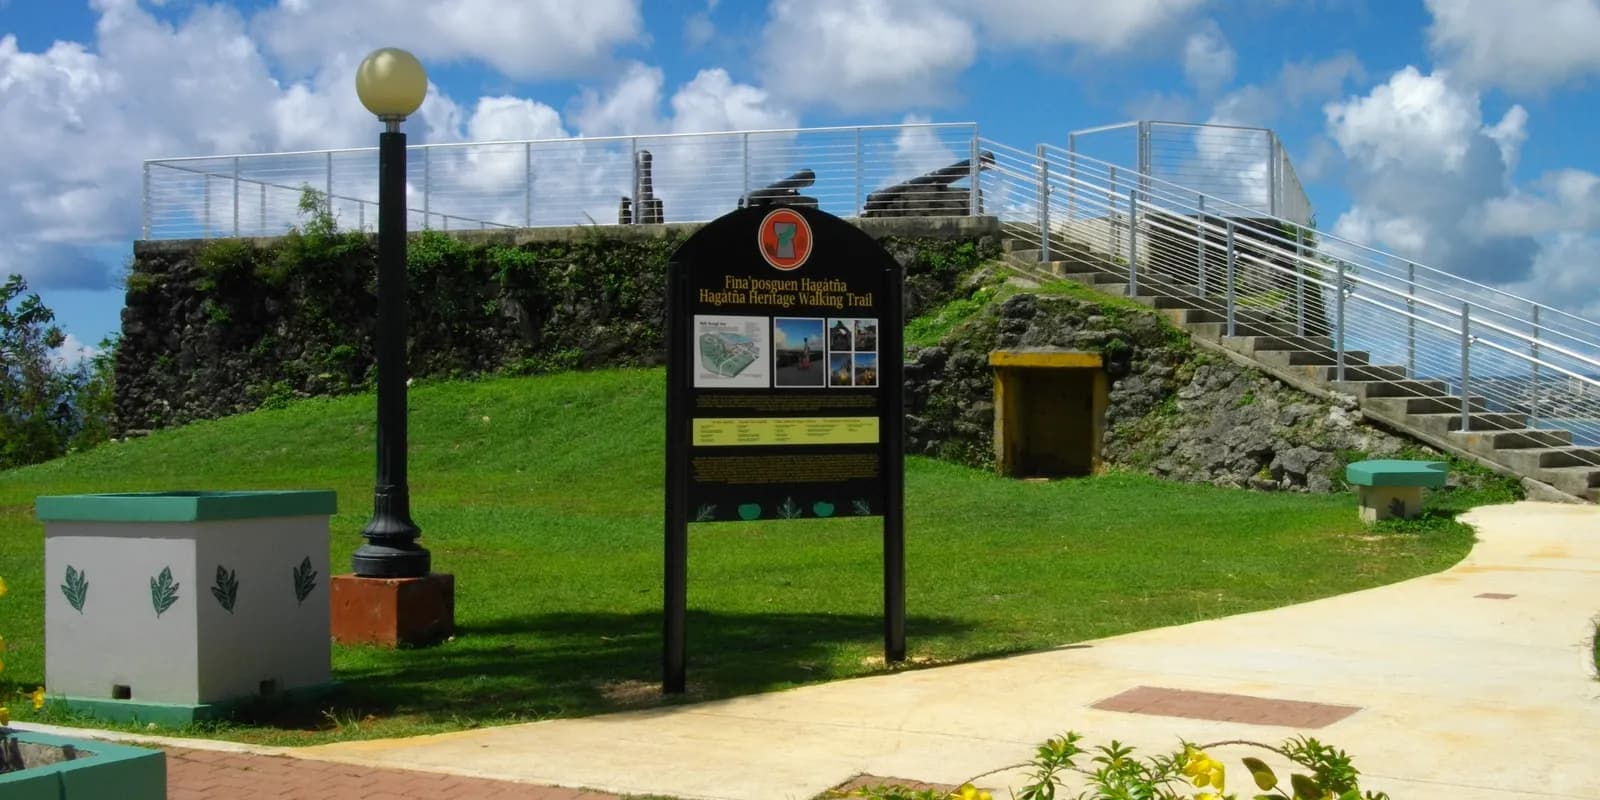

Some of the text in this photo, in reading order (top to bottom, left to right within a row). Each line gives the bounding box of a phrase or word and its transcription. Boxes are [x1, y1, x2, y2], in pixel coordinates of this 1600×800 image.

[750, 291, 796, 308] Heritage
[799, 291, 843, 309] Walking
[847, 293, 872, 307] Trail
